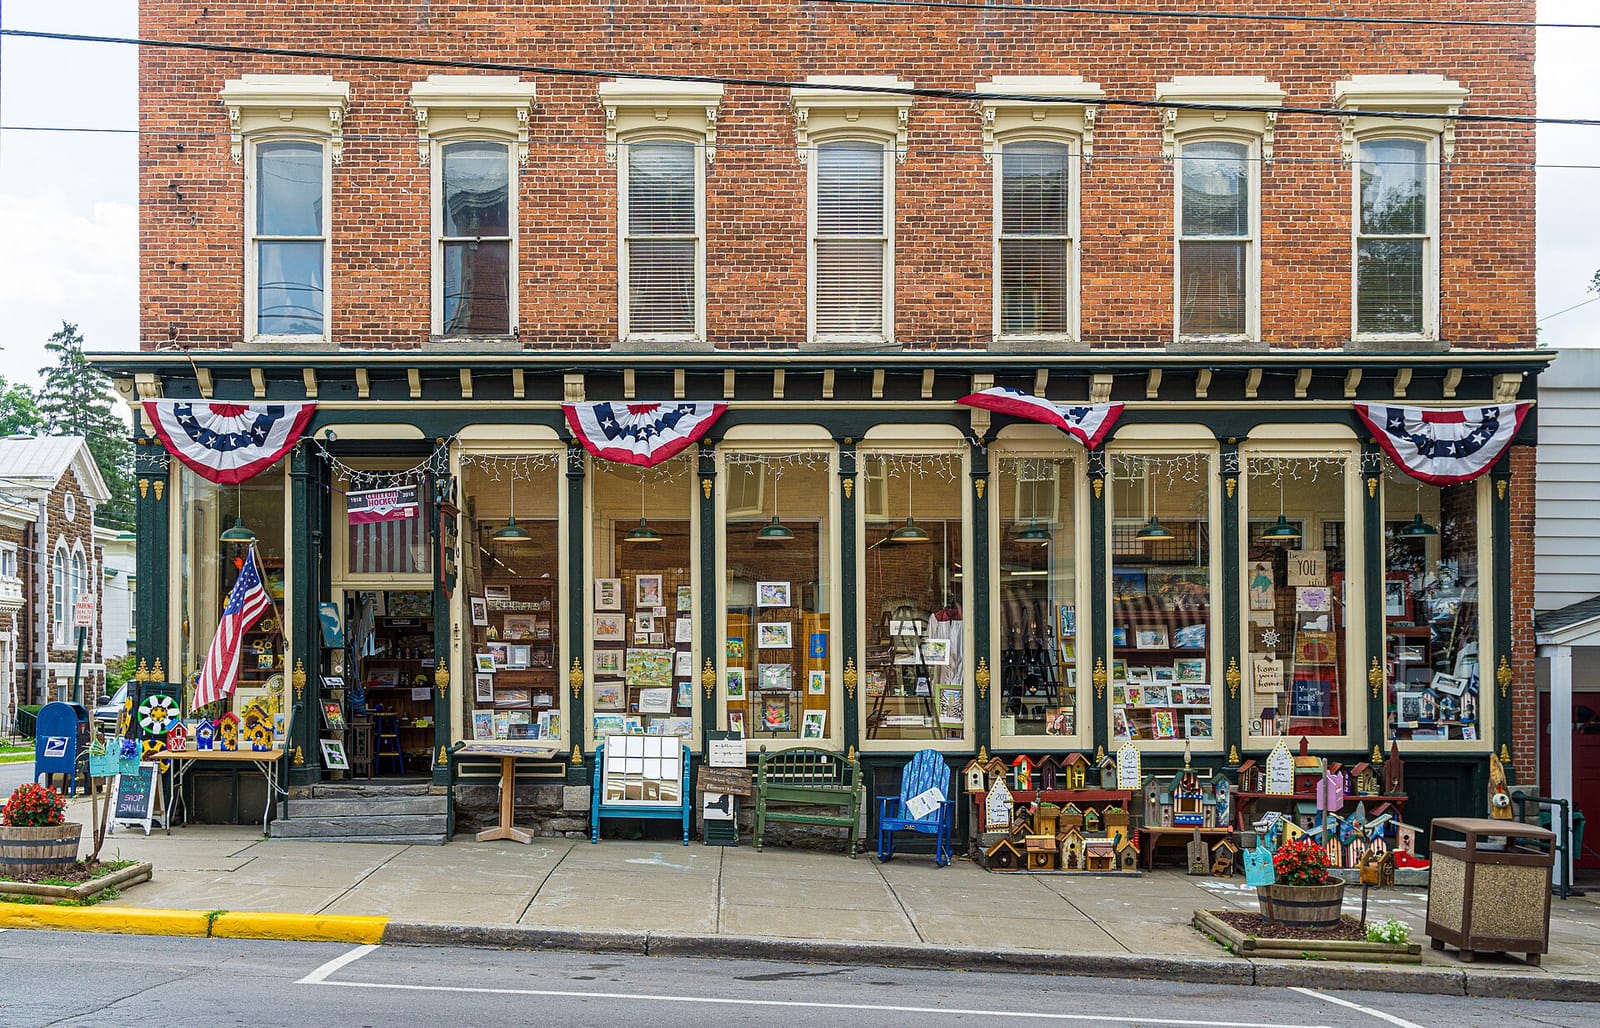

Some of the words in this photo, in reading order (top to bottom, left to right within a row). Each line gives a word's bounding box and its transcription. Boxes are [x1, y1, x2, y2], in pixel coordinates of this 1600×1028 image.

[368, 497, 397, 507] HOCKEY
[1297, 559, 1316, 576] YOU
[1257, 664, 1279, 672] home
[1258, 680, 1280, 688] home
[124, 793, 145, 802] SHOP
[119, 803, 146, 812] SMALL
